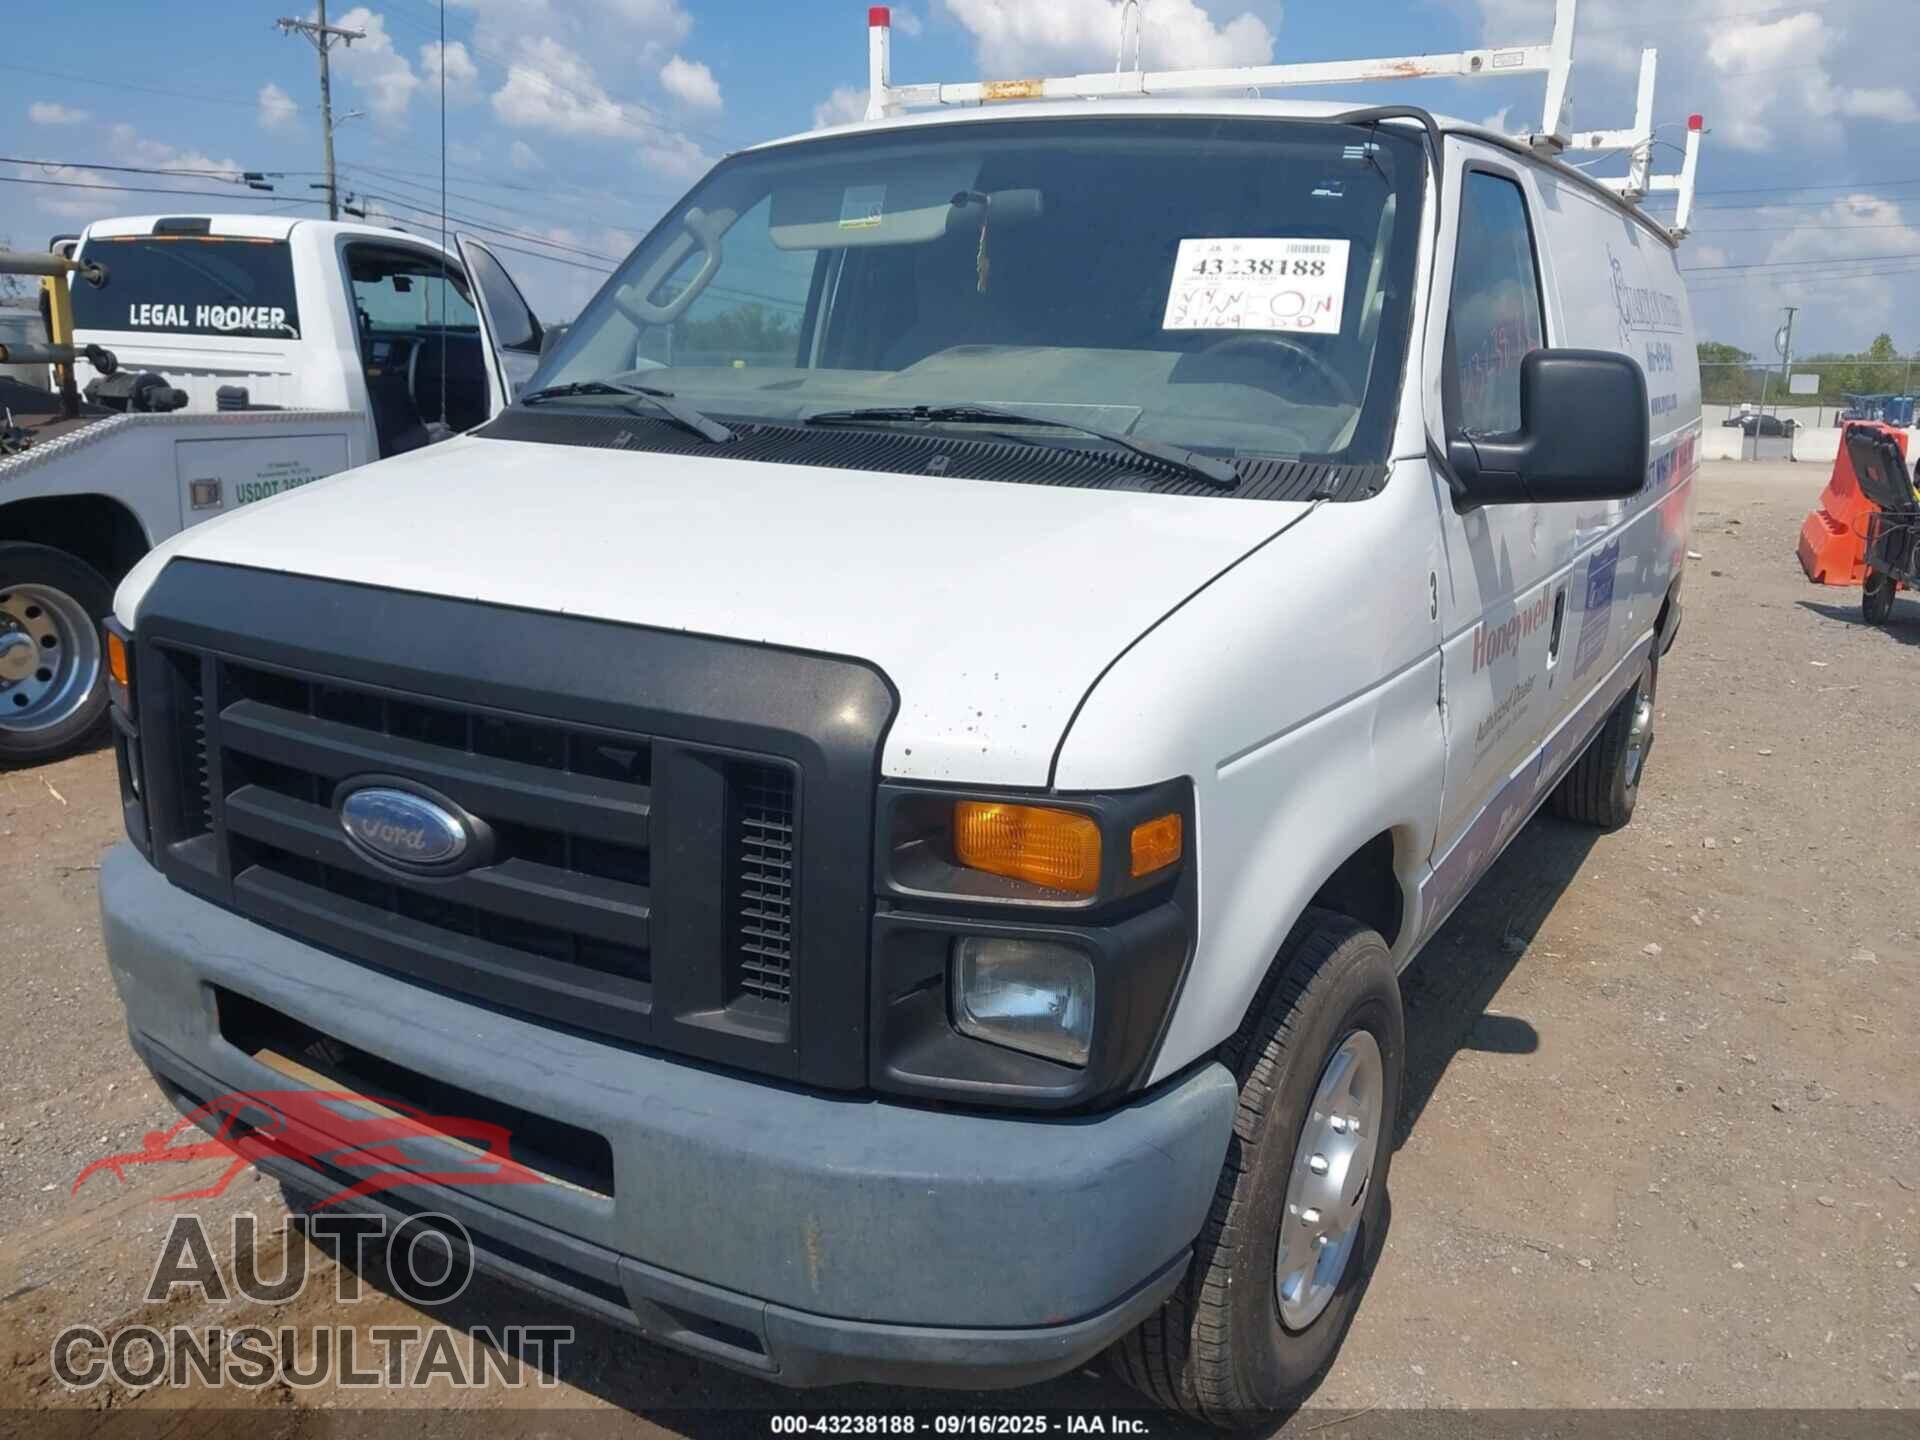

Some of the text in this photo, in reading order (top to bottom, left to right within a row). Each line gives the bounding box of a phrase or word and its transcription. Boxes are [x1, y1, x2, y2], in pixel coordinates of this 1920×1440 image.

[129, 303, 286, 330] LEGAL HOOKER
[235, 479, 279, 504] USDOT
[1430, 571, 1438, 621] 3
[1472, 583, 1550, 674] Honeywell
